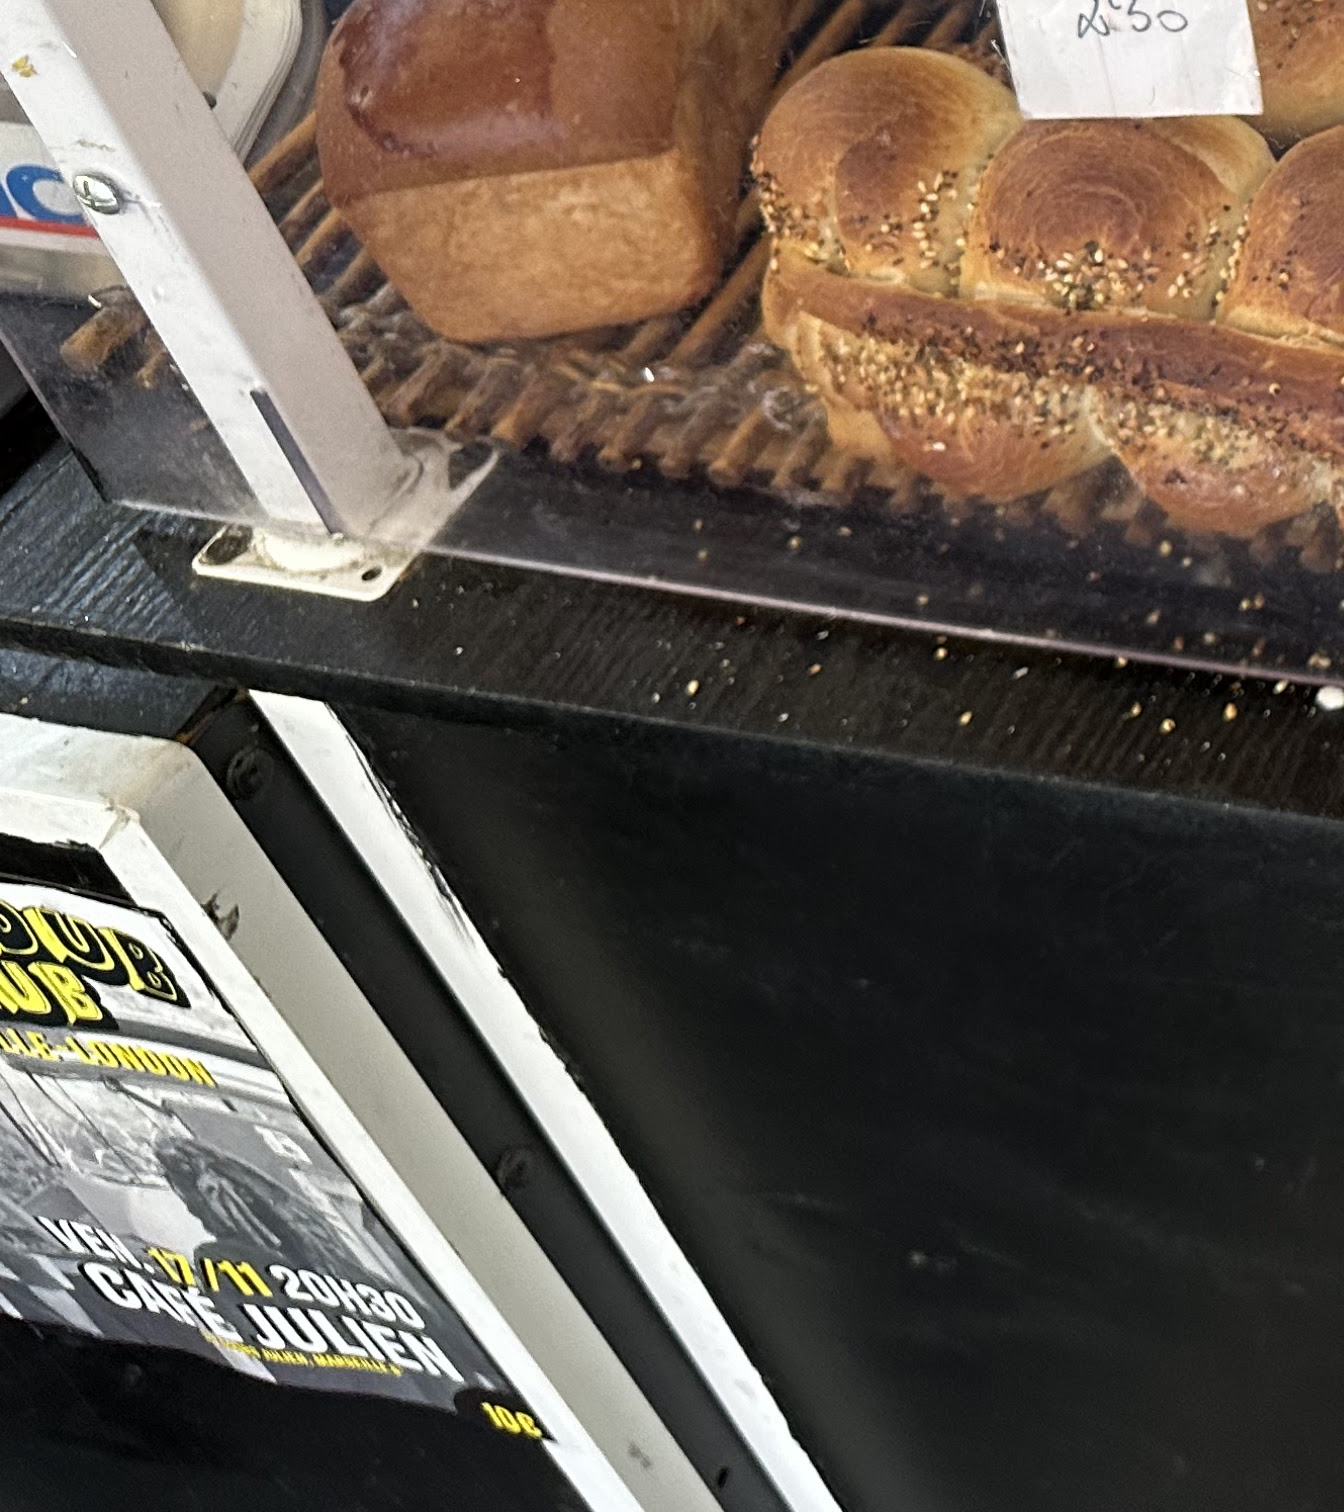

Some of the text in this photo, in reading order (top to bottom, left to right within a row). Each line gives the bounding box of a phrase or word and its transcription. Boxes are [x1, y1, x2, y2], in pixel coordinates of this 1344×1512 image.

[36, 1215, 426, 1330] VEN. 17/11 20H30
[242, 1303, 466, 1383] JULIEN
